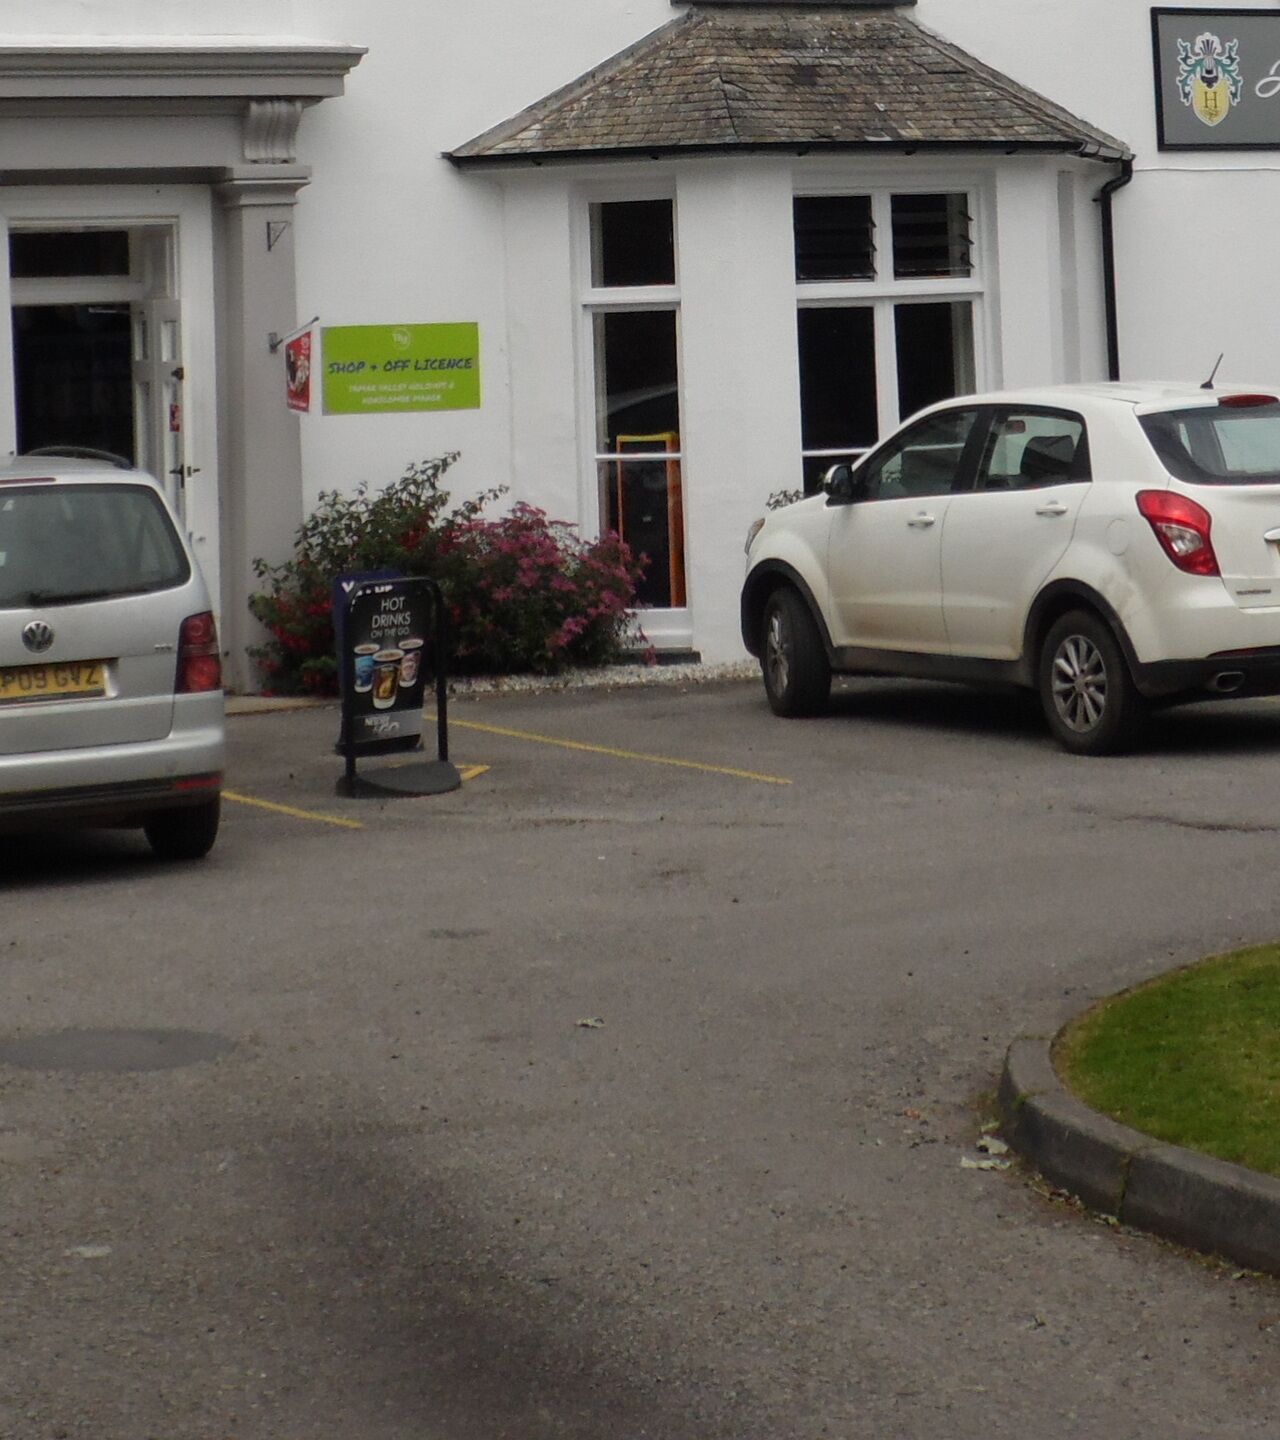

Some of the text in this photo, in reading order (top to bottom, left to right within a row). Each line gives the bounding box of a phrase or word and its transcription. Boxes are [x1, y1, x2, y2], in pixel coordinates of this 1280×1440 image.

[328, 361, 365, 374] SHOP
[384, 360, 410, 371] OFF
[415, 358, 473, 371] LICENCE
[381, 596, 405, 611] HOT
[372, 612, 411, 628] DRINKS
[54, 664, 99, 687] GVZ
